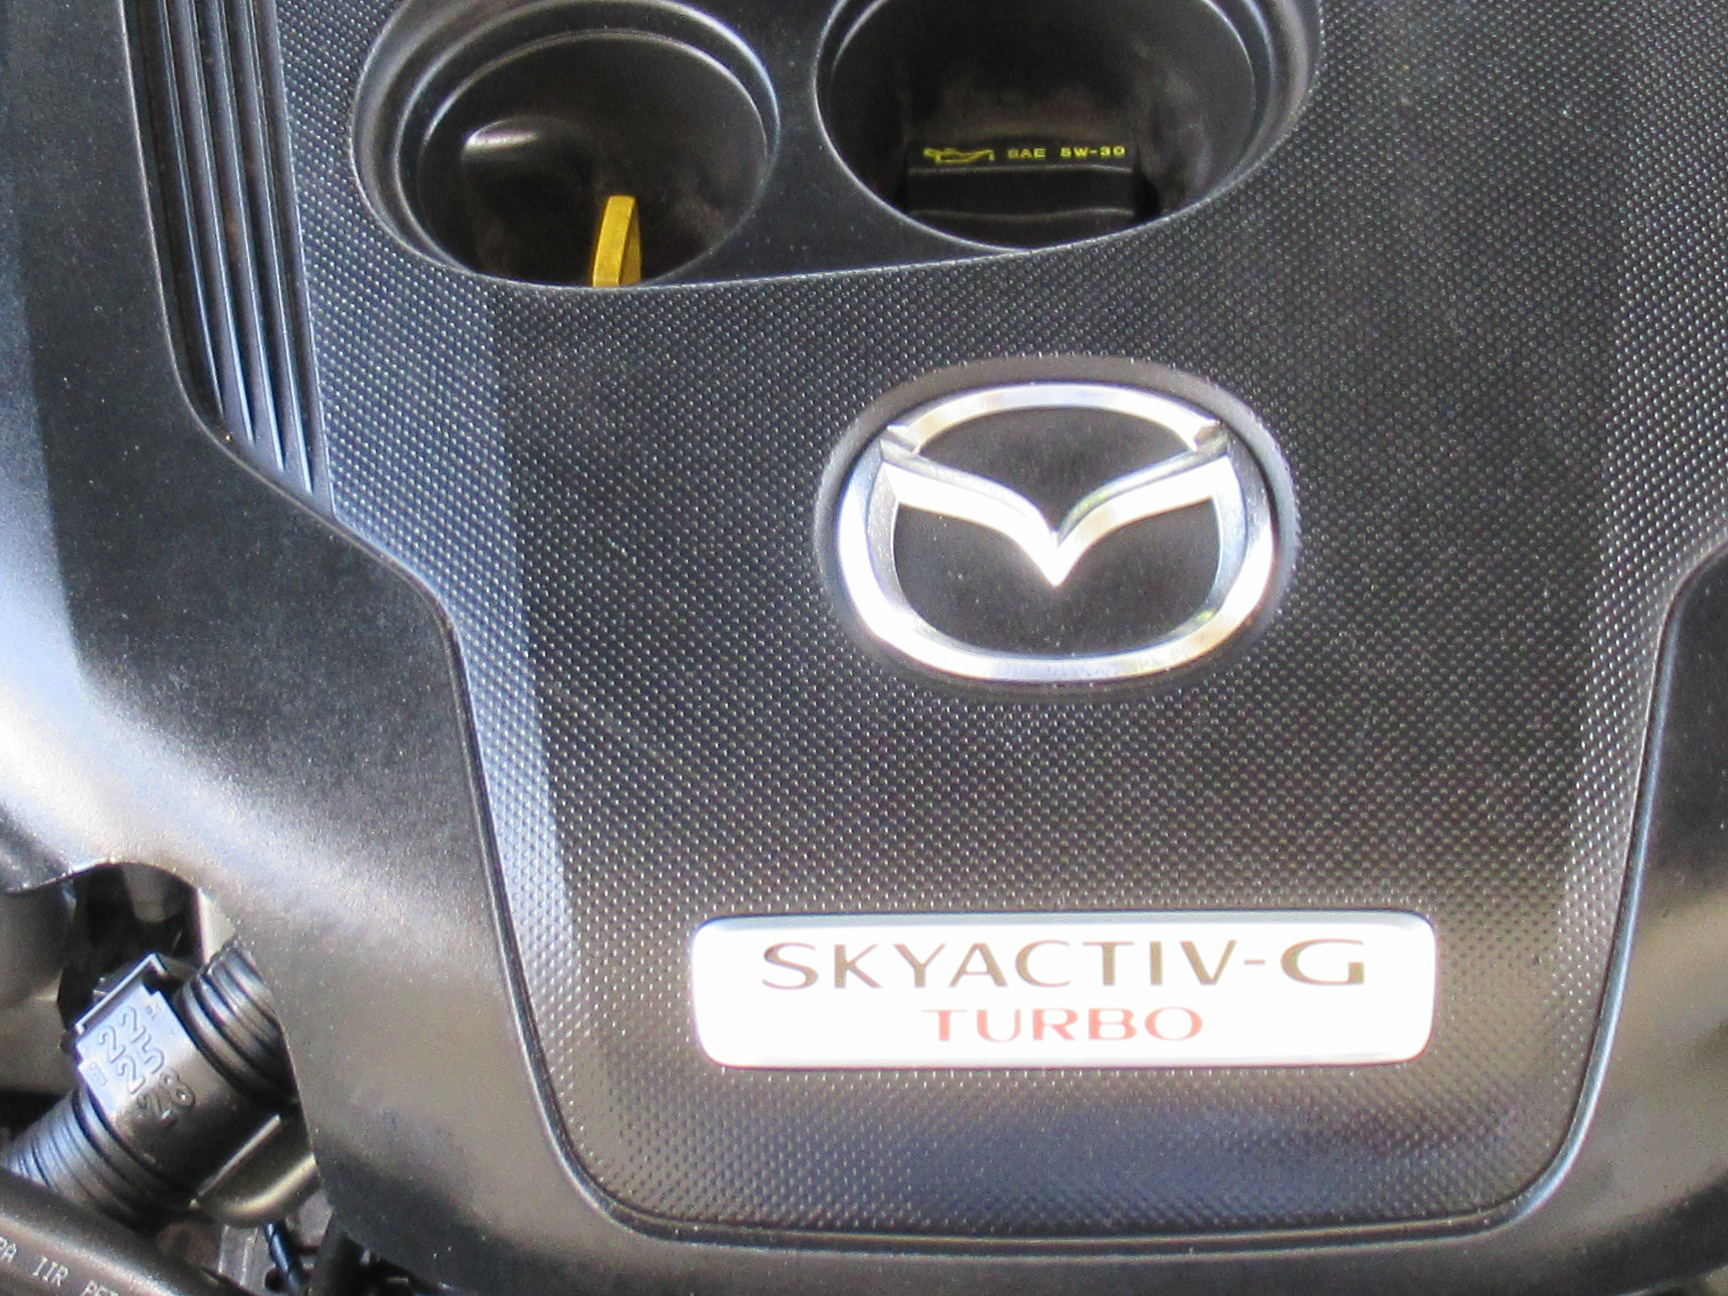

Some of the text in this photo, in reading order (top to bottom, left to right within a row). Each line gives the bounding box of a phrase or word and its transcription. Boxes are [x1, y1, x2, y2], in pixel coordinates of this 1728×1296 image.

[1007, 144, 1127, 160] SAE 5W-30
[760, 937, 1366, 990] SKYACTIV-G
[921, 1006, 1204, 1043] TURBO
